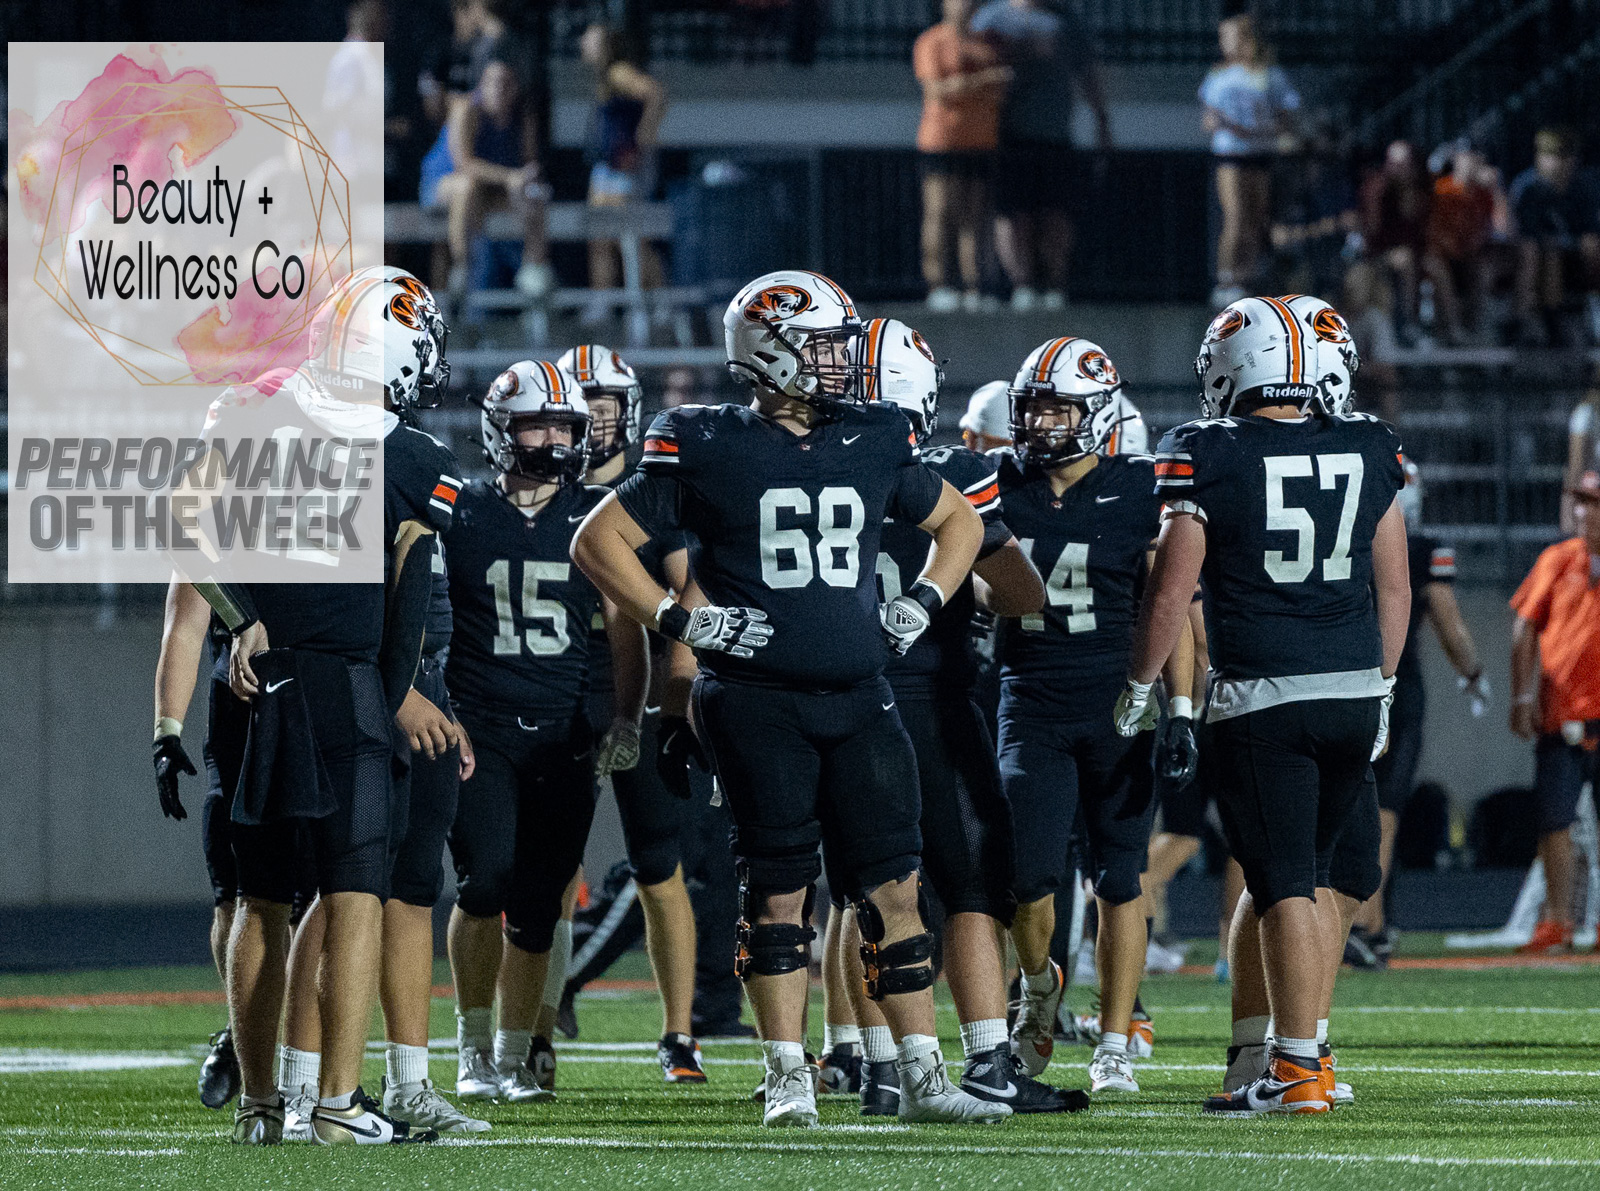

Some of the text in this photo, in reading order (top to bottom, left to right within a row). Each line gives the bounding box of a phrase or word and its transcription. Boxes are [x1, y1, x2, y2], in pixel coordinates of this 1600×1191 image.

[311, 367, 364, 390] Riddell
[1262, 386, 1314, 398] Riddell
[760, 486, 865, 589] 68
[1263, 453, 1364, 583] 57
[486, 559, 571, 655] 15
[894, 606, 918, 624] adidas
